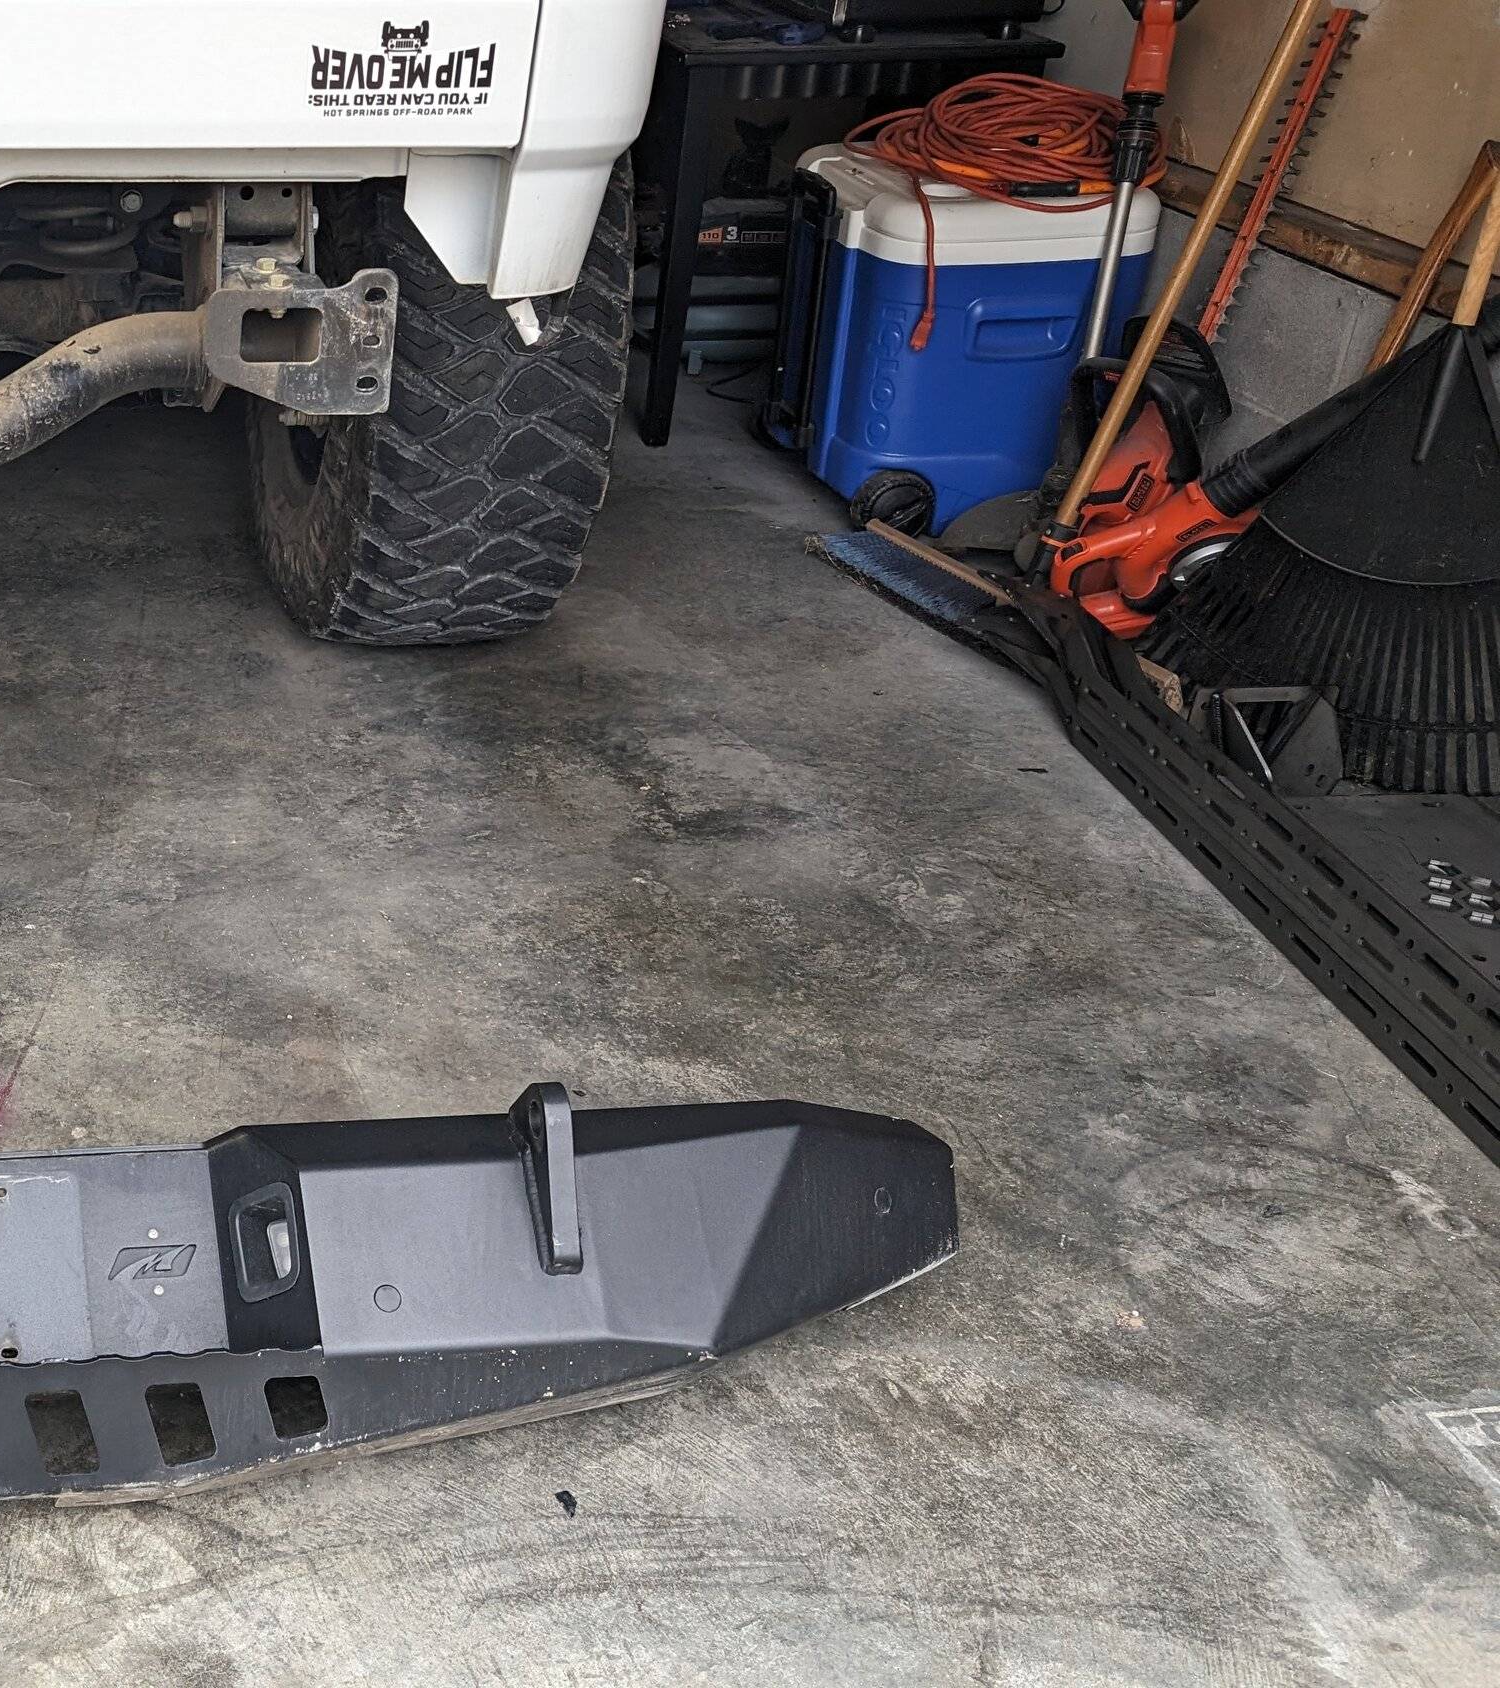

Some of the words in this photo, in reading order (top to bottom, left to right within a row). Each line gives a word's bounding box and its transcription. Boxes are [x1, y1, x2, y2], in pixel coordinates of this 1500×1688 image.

[311, 44, 386, 90] OVER
[389, 54, 432, 89] ME
[435, 43, 497, 89] FLIP
[308, 94, 350, 106] THIS:
[354, 93, 397, 106] READ
[401, 93, 434, 106] CAN
[438, 92, 470, 105] YOU
[473, 92, 488, 105] IF
[323, 109, 343, 117] HOT
[346, 108, 389, 116] SPRINGS
[393, 107, 444, 116] OFF-ROAD
[447, 107, 474, 115] PARK
[726, 226, 738, 240] 3
